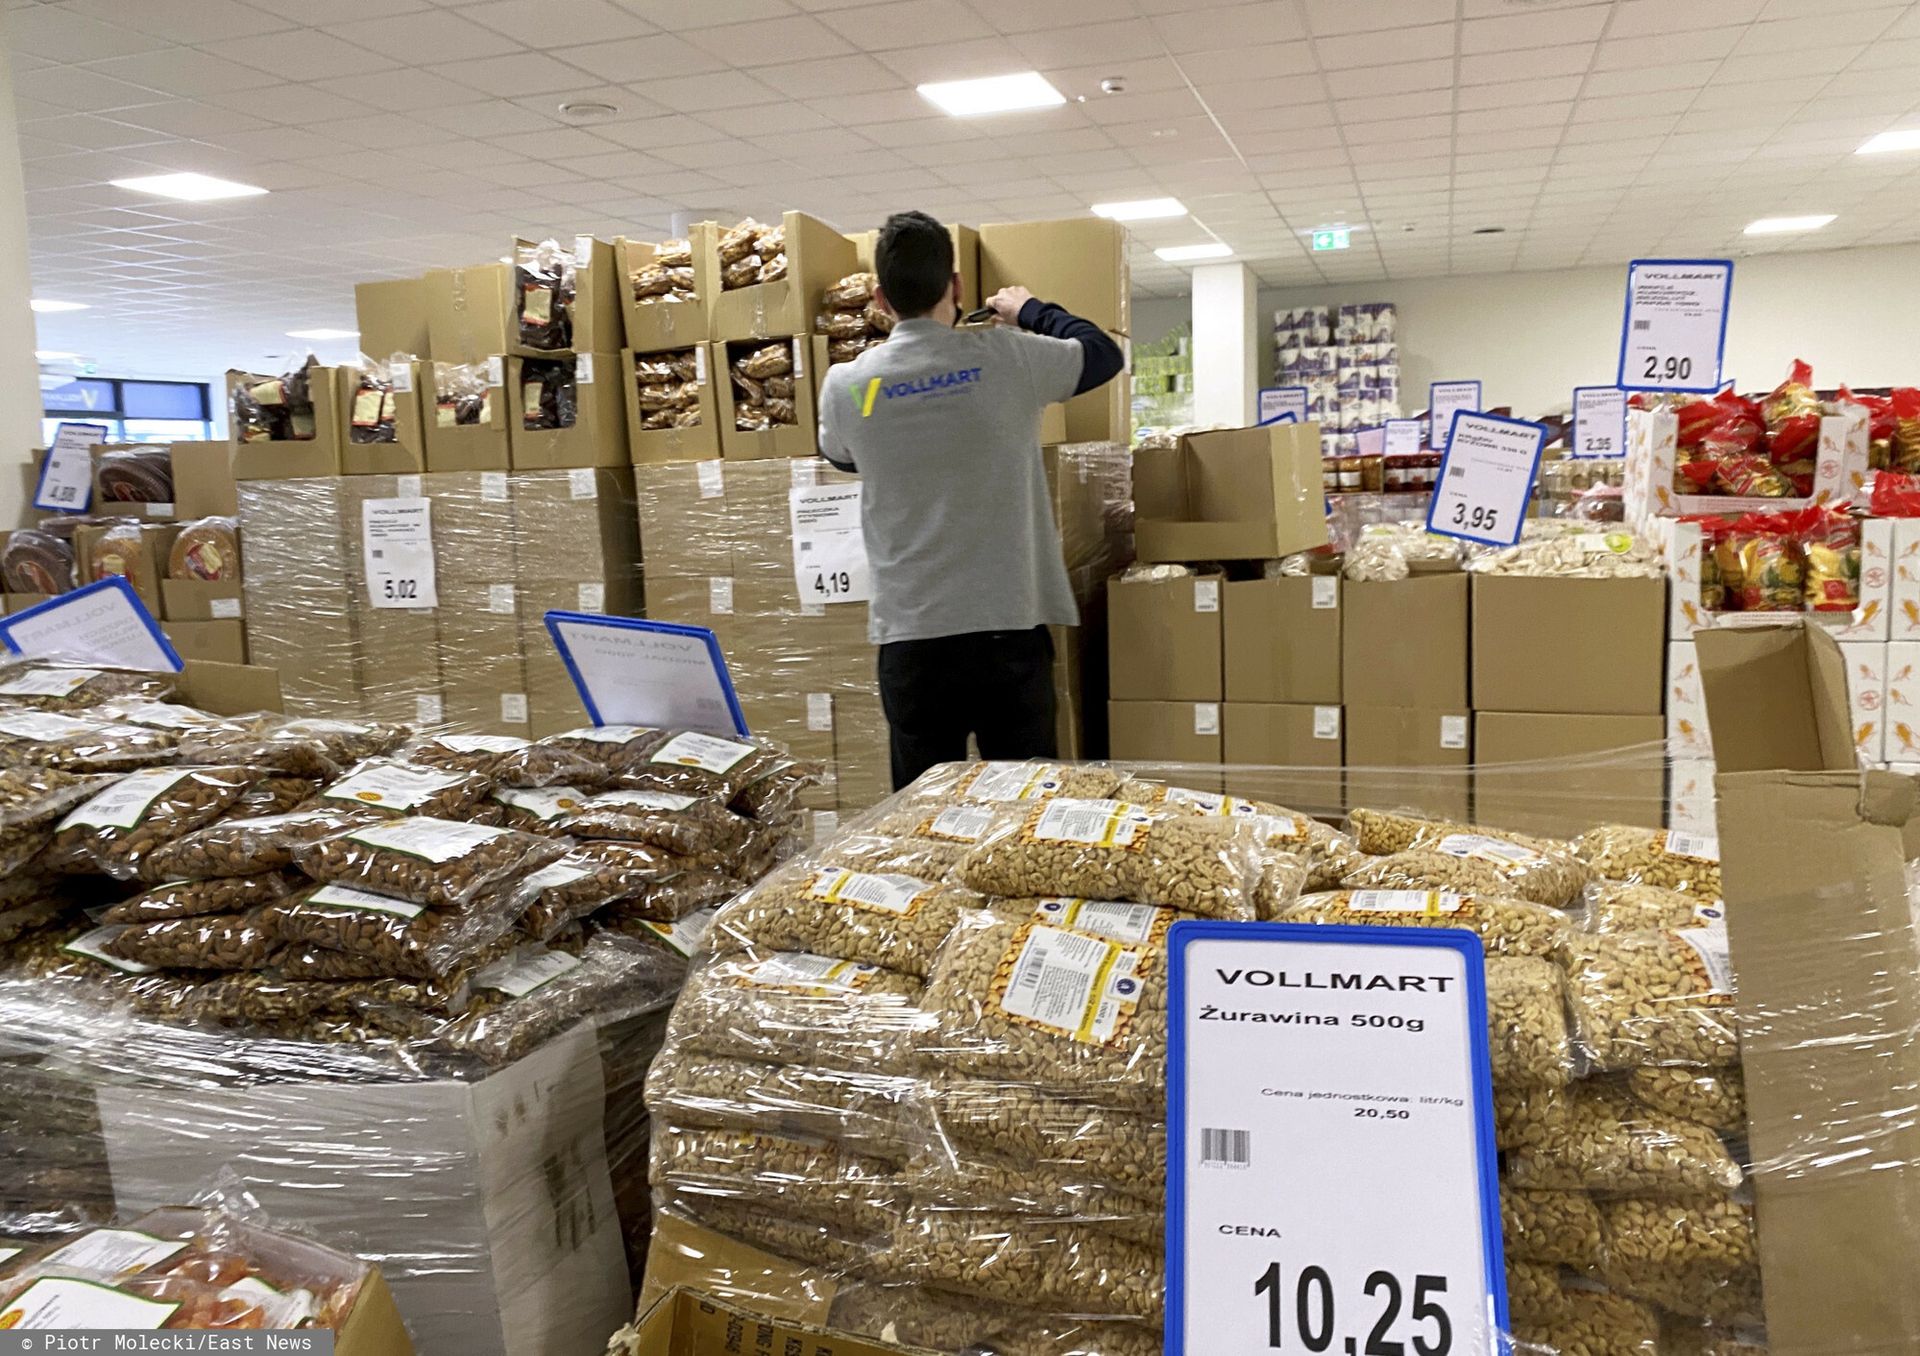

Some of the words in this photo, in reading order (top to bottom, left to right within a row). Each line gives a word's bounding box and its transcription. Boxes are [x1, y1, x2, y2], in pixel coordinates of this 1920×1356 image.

[1643, 355, 1692, 383] 2,90
[882, 367, 982, 399] VOLLMART
[1465, 422, 1538, 441] VOLLMART
[800, 493, 859, 504] VOLLMART
[1452, 502, 1499, 531] 3,95
[385, 579, 417, 602] 5,02
[814, 571, 850, 597] 4,19
[1216, 968, 1454, 994] VOLLMART
[1199, 1004, 1340, 1026] Żurawina
[1351, 1013, 1425, 1033] 500g
[1261, 1087, 1304, 1099] Cena
[1307, 1090, 1413, 1104] jednostkowa:
[1418, 1096, 1465, 1107] litr/kg
[1353, 1107, 1411, 1120] 20,50
[1218, 1224, 1282, 1239] CENA
[1254, 1261, 1453, 1356] 10,25
